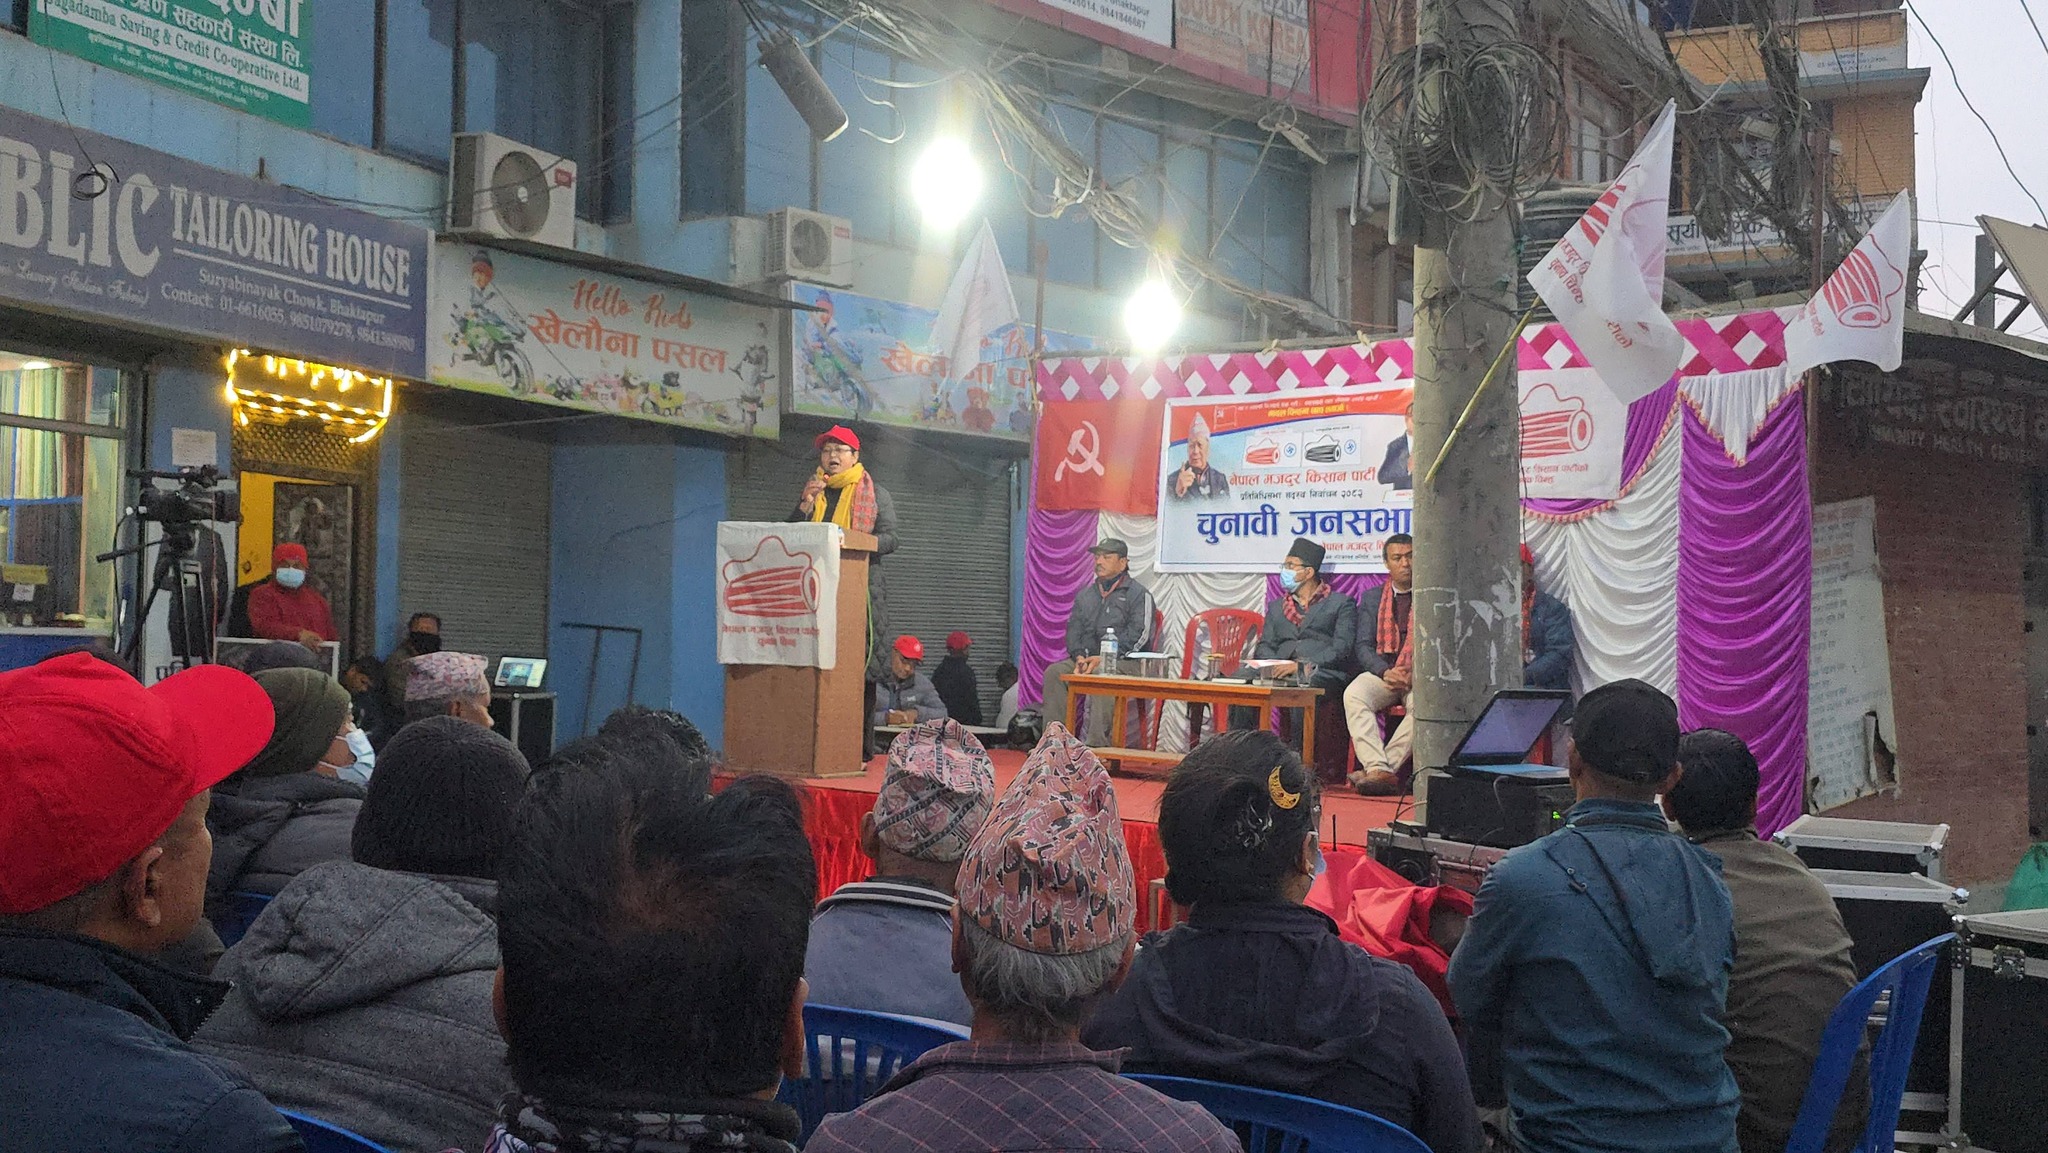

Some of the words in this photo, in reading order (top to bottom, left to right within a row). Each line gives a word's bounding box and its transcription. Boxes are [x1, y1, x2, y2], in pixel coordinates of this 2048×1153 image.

[120, 14, 160, 46] Saving
[163, 28, 171, 46] &
[175, 33, 210, 59] Credit
[173, 4, 233, 42] सहकारी
[238, 28, 278, 59] संस्था
[170, 183, 319, 274] TAILORING
[325, 228, 411, 298] HOUSE
[569, 278, 632, 318] Hello
[528, 308, 641, 358] खेलौना
[652, 337, 729, 374] पसल
[1229, 472, 1259, 486] नेपाल
[1306, 469, 1346, 484] किसान
[1352, 466, 1376, 481] पार्टी
[1197, 503, 1279, 544] चुनावी
[1289, 508, 1413, 536] जनसभा
